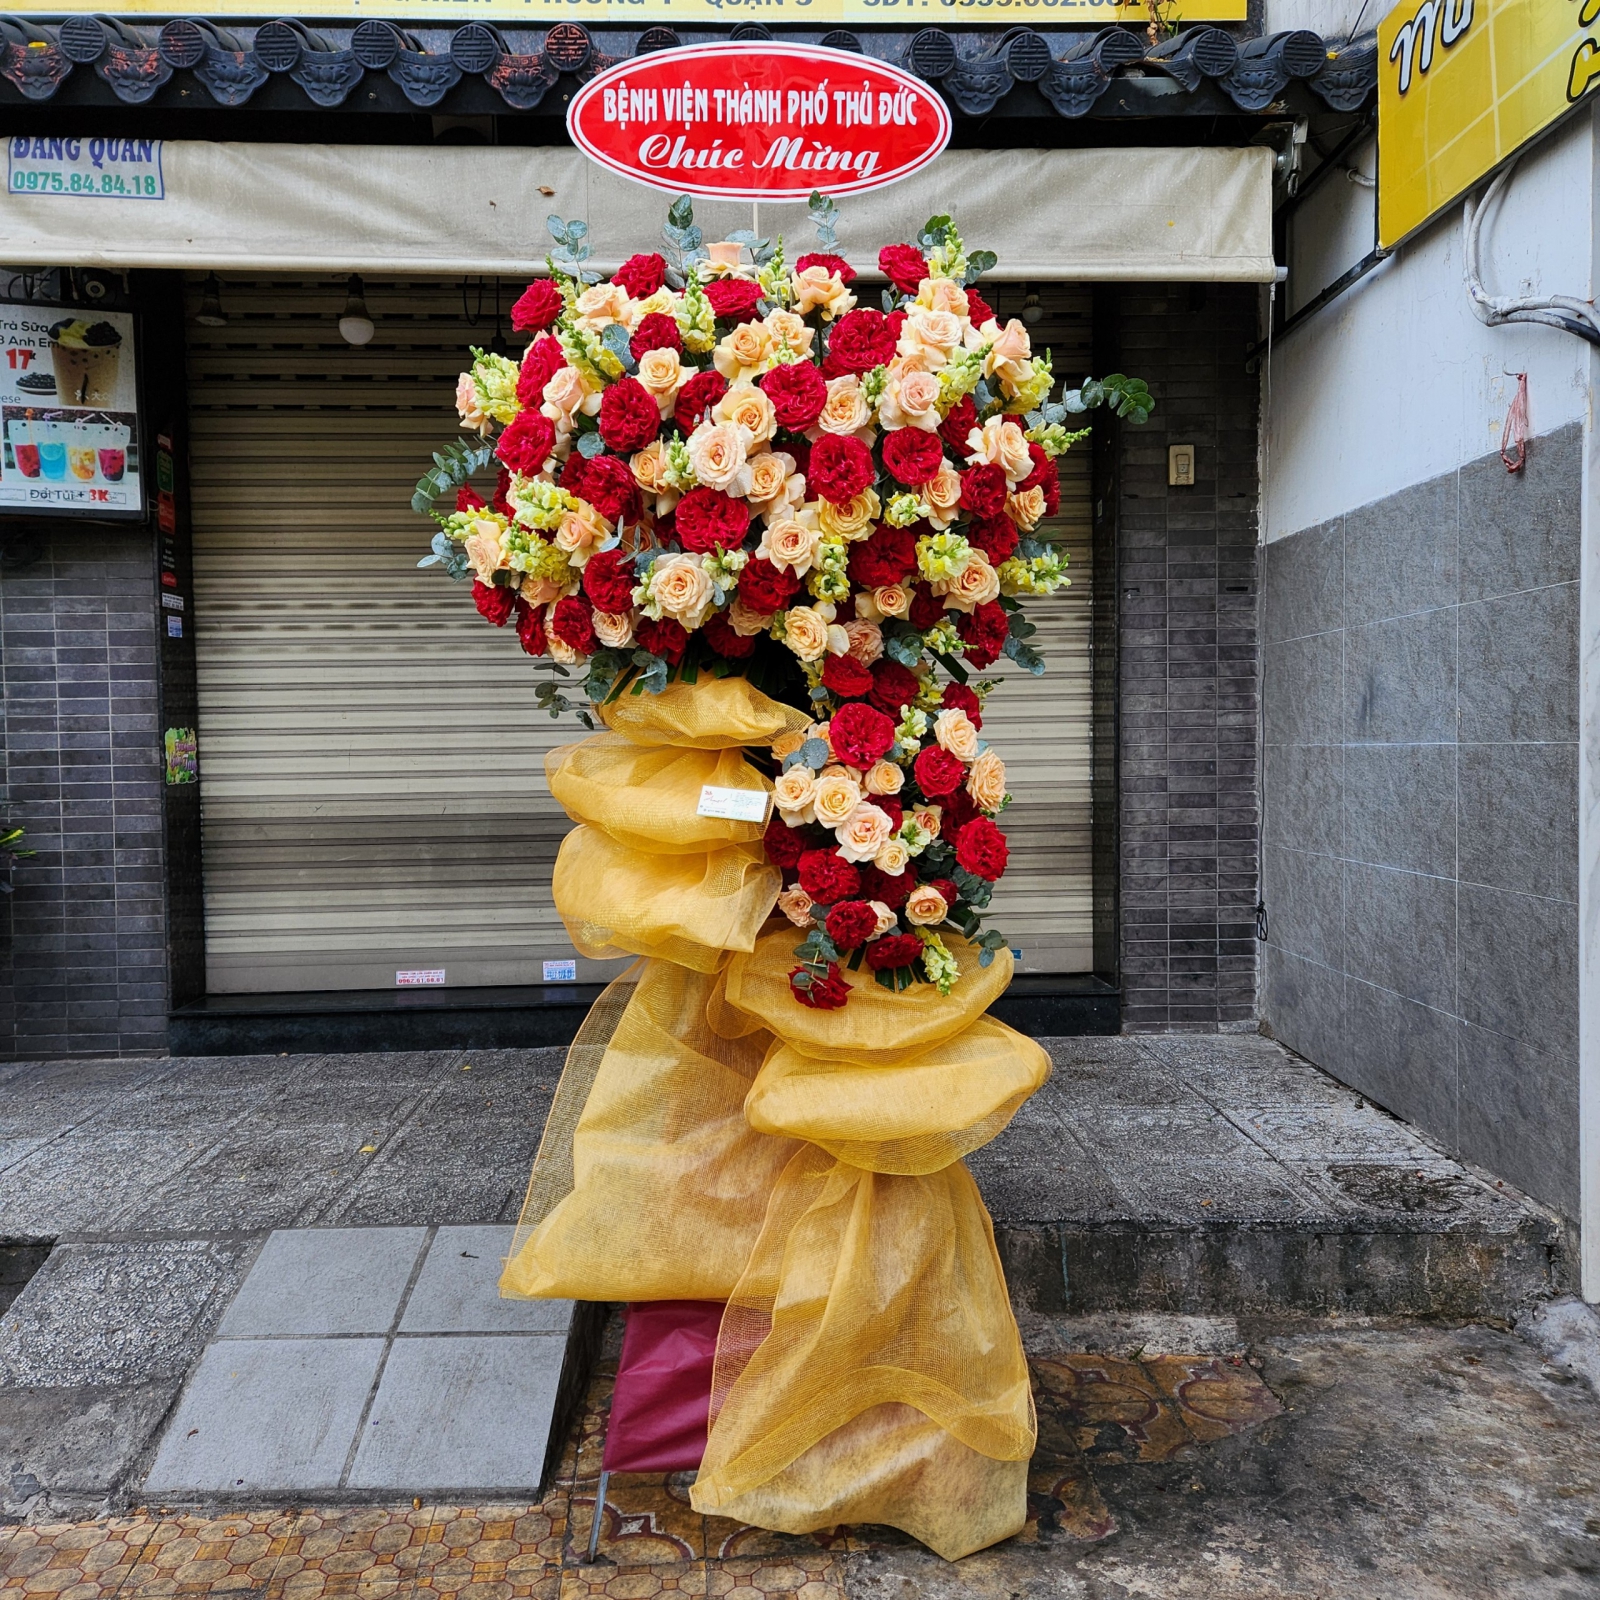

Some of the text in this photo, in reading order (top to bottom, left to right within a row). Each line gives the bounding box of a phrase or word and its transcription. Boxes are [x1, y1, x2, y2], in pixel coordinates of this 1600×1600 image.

[602, 78, 917, 130] BỆNH VIỆN THÀNH PHỐ THỦ ĐỨC
[638, 133, 883, 179] Chúc Mừng
[13, 171, 156, 195] 0975.84.84.18
[21, 321, 49, 333] Sữa
[8, 335, 36, 347] Anh
[39, 338, 60, 348] Em
[89, 489, 109, 501] 3K
